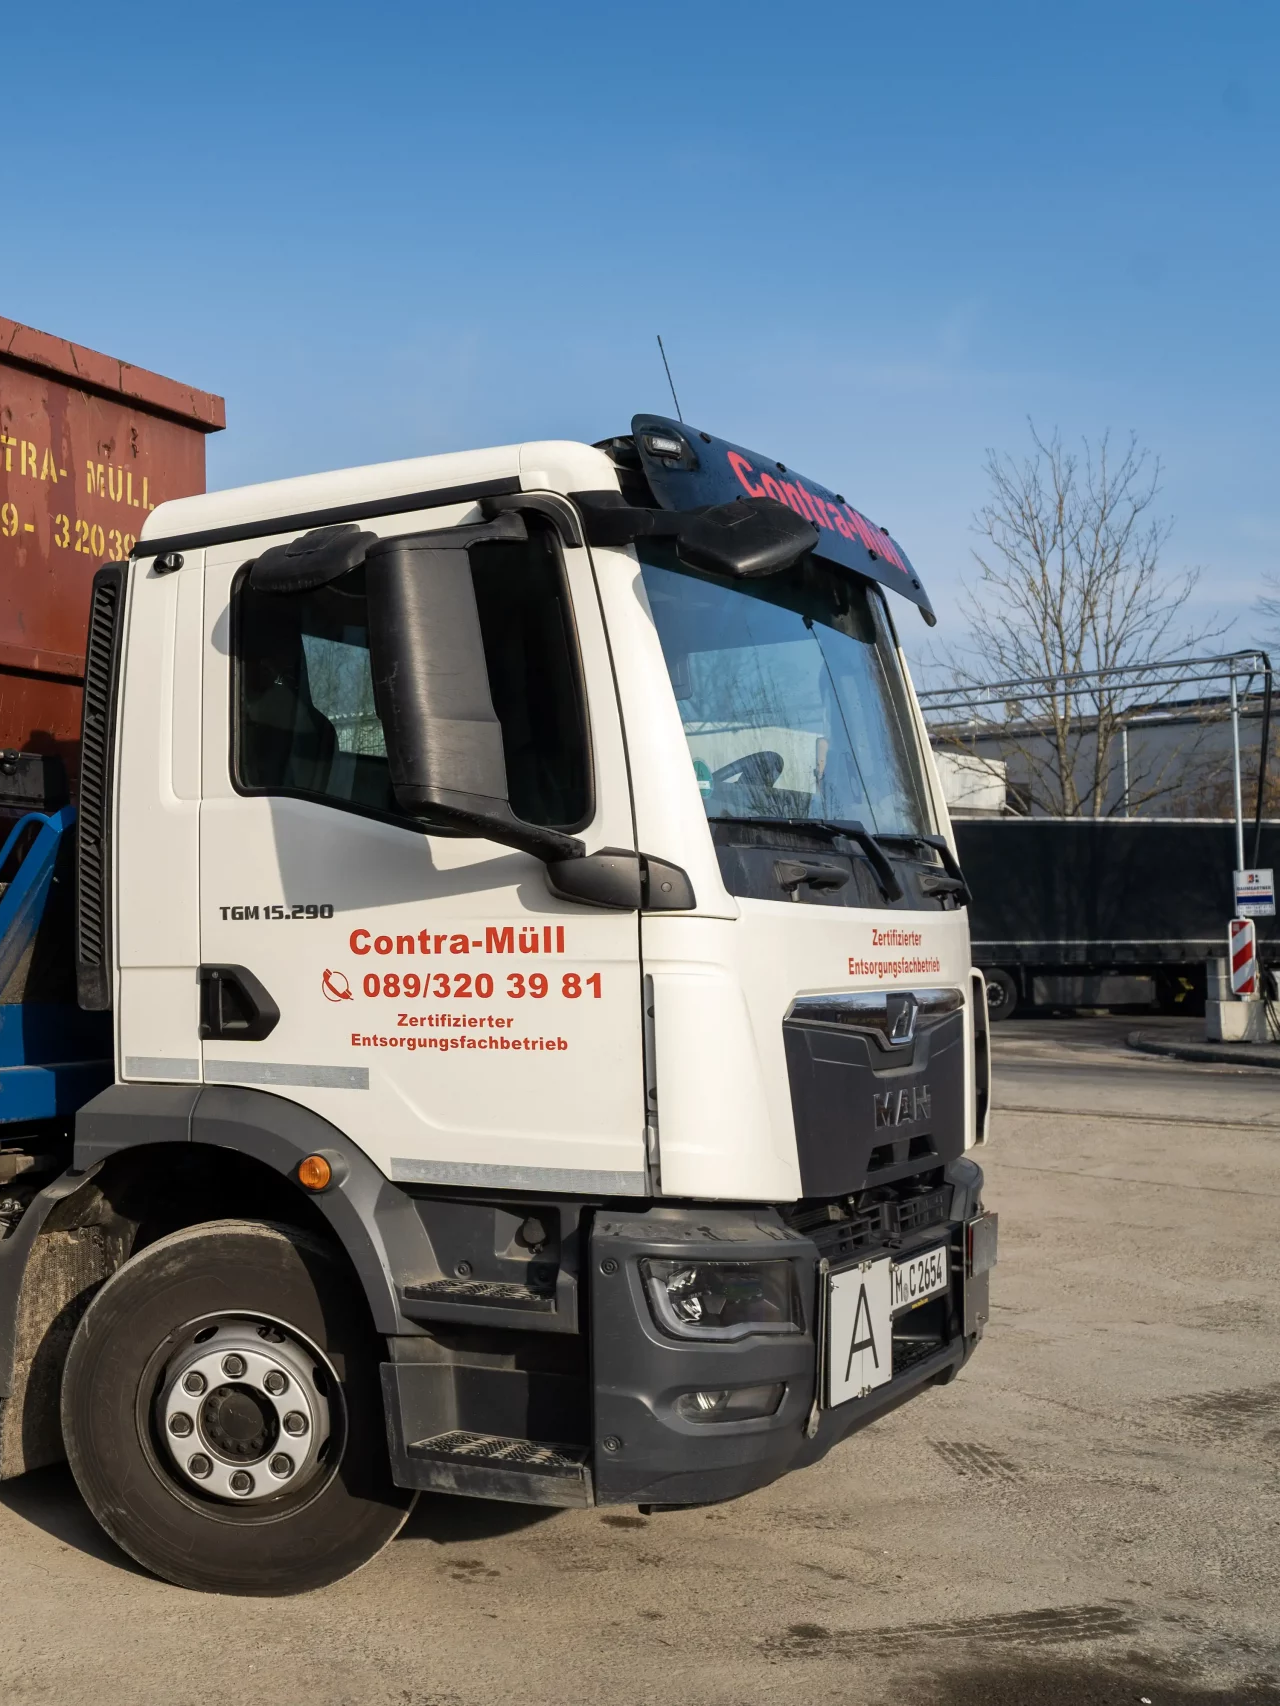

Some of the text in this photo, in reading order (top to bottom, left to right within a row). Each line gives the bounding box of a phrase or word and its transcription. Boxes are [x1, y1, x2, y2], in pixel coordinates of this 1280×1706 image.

[86, 460, 155, 511] MÜLL
[219, 904, 334, 921] TGM 15.290
[349, 926, 565, 955] Contra-Müll
[872, 929, 922, 946] Zertifizierter
[848, 957, 940, 979] Entsorgungsfachbetrieb
[363, 973, 602, 999] 089/320 39 81
[397, 1014, 514, 1028] Zertifizierter
[351, 1034, 568, 1052] Entsorgungsfachbetrieb
[872, 1084, 931, 1131] MAN
[918, 1252, 942, 1294] 2654
[845, 1282, 880, 1382] A
